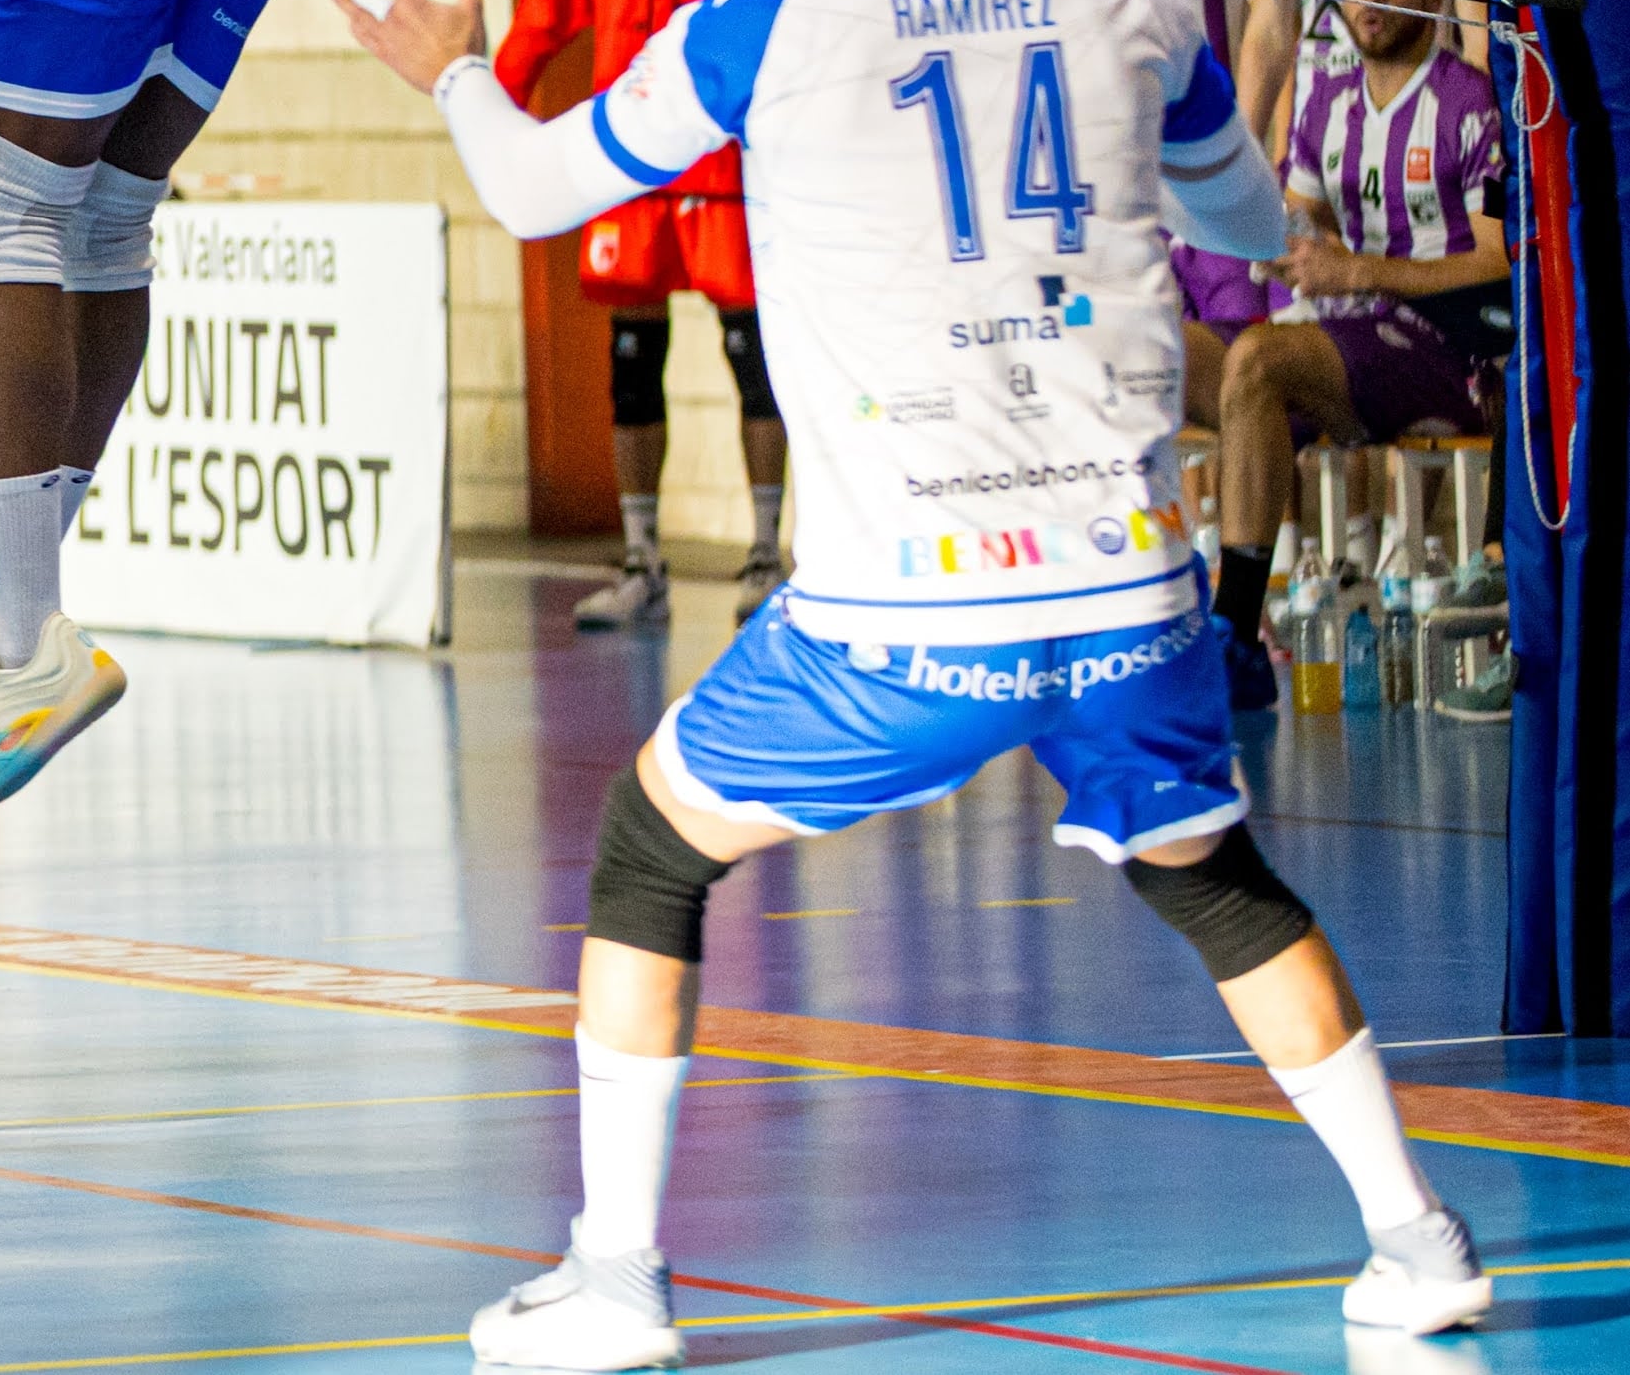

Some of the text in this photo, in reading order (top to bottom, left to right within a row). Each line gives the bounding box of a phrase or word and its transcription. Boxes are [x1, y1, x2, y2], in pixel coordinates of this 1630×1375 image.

[889, 41, 1094, 263] 14
[175, 222, 338, 285] Valenciana
[129, 316, 338, 427] UNITAT
[949, 311, 1061, 349] suma
[127, 445, 391, 561] L'ESPORT
